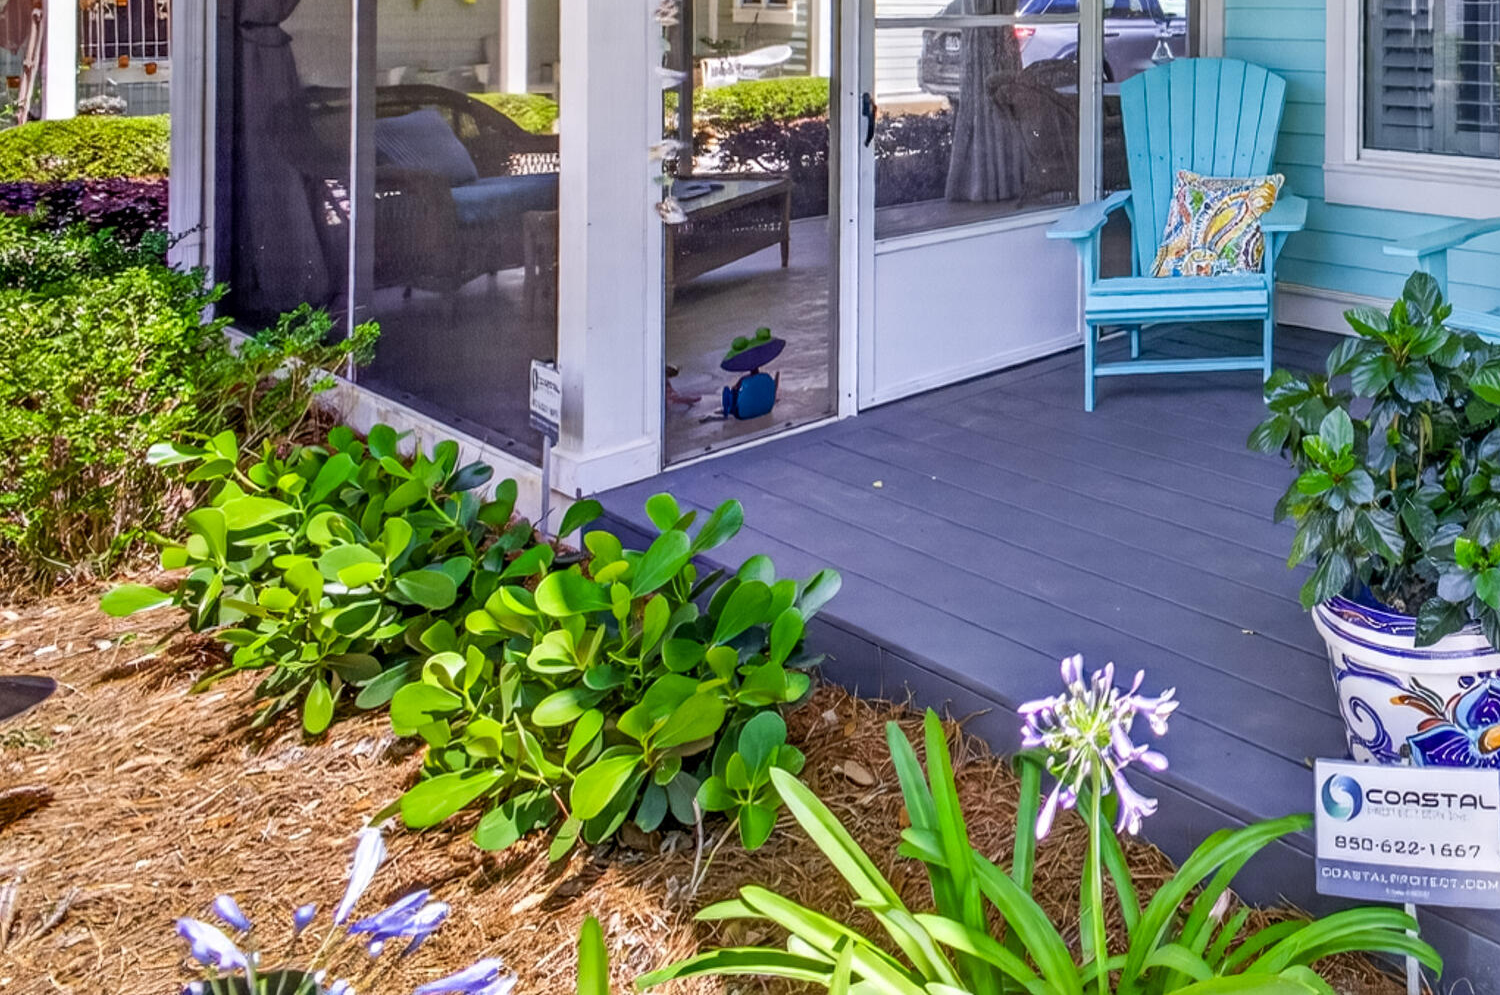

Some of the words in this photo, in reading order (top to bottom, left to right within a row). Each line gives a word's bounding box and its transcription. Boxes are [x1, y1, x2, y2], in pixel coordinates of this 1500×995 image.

[1365, 789, 1497, 810] COASTAL
[1334, 835, 1481, 859] 850-622-1667
[1321, 866, 1499, 891] COASTALPROTECT.COM
